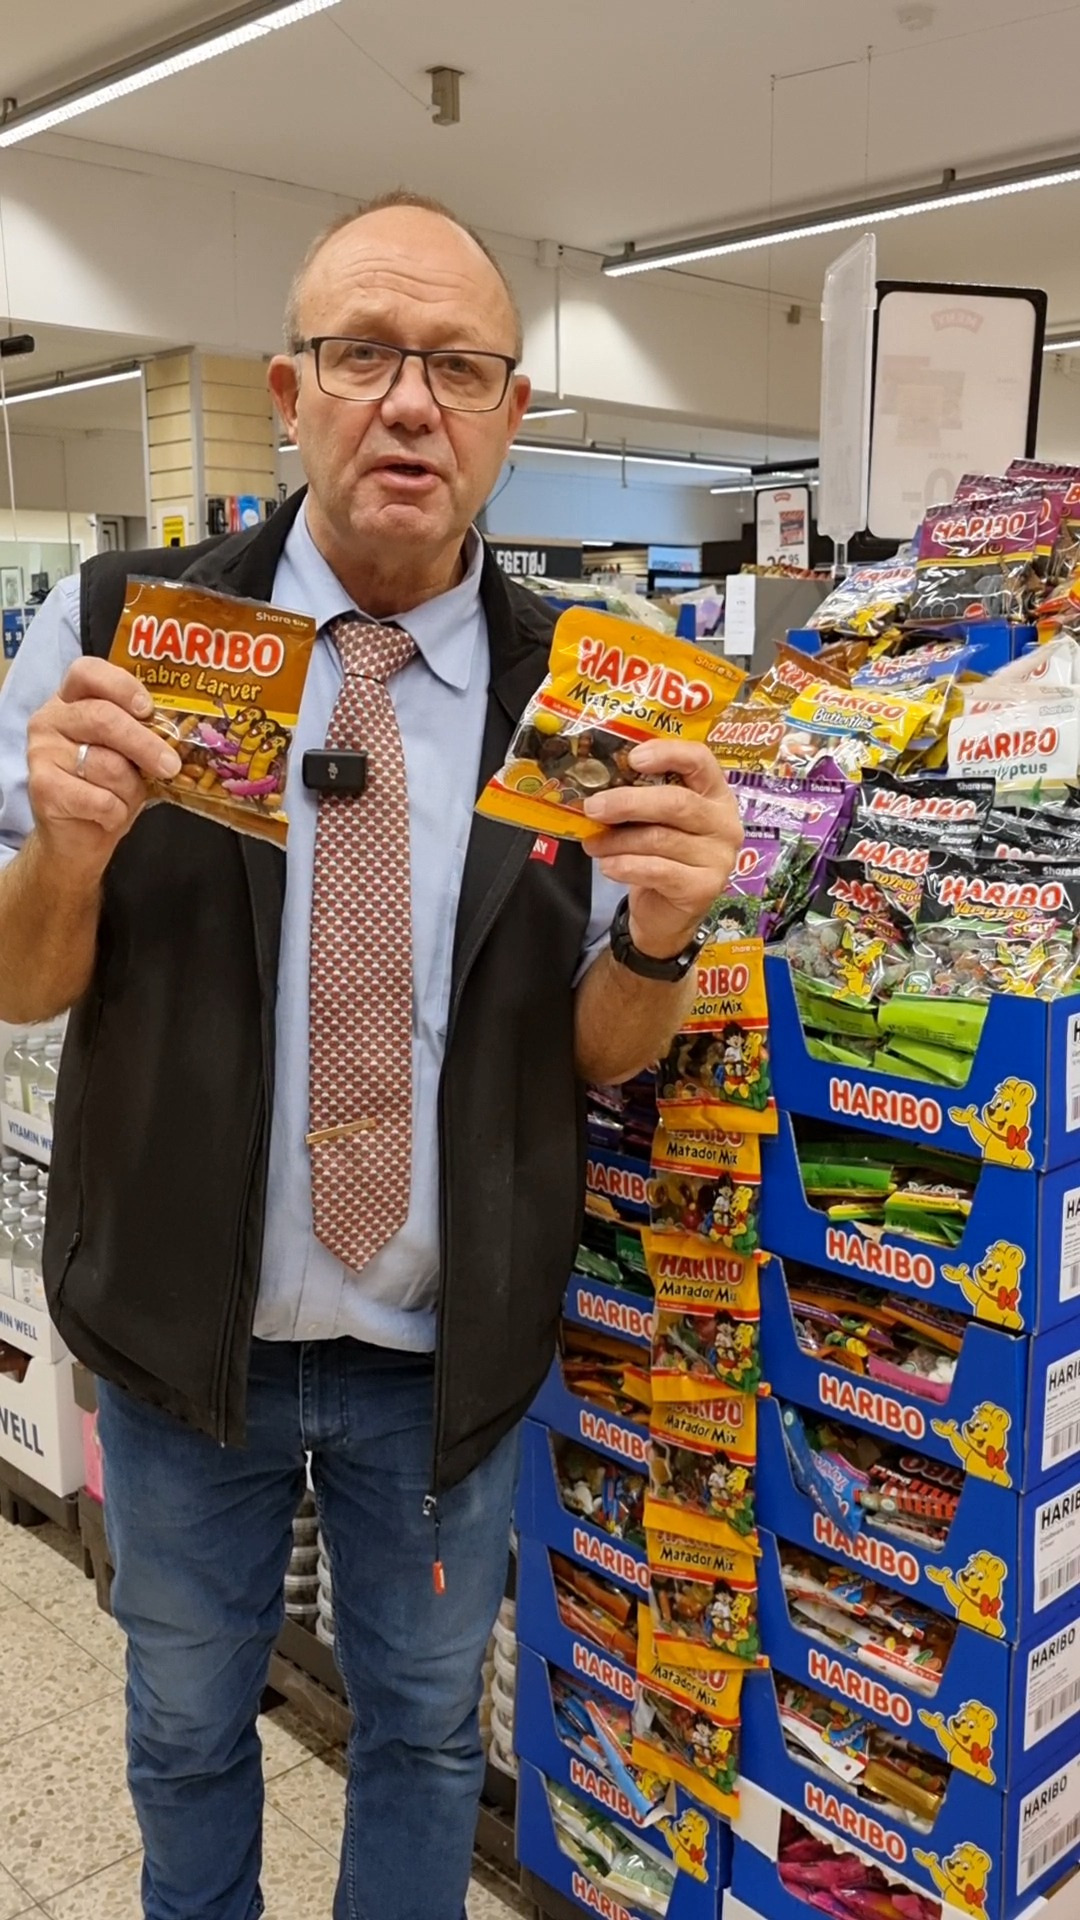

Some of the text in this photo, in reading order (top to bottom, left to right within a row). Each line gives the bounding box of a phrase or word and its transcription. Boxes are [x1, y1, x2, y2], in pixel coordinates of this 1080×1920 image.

[492, 550, 547, 575] EGETØJ
[256, 611, 291, 625] Share
[129, 614, 285, 677] HARIBO
[134, 664, 262, 701] Labre Larver
[577, 636, 713, 715] HARIBO
[695, 655, 725, 675] Share
[567, 681, 652, 724] Matador
[654, 715, 684, 736] Mix
[812, 707, 875, 730] Butterflies
[813, 687, 908, 721] HARIBO
[707, 721, 787, 747] HARIBO
[956, 726, 1060, 765] HARIBO
[847, 840, 930, 877] HARIB
[897, 892, 922, 902] Sou
[938, 876, 1064, 912] HARIBO
[697, 963, 749, 999] RIBO
[690, 1000, 743, 1016] ador Mix
[830, 1077, 943, 1134] HARIBO
[7, 1120, 40, 1147] VITAMIN
[666, 1141, 738, 1165] Matador Mix
[658, 1255, 744, 1286] HARIBO
[826, 1227, 935, 1290] HARIBO
[659, 1282, 714, 1300] Matador
[14, 1317, 38, 1341] WELL
[819, 1372, 926, 1440] HARIBO
[664, 1415, 737, 1445] Matador Mix
[573, 1527, 650, 1591] HARIBO
[660, 1546, 735, 1572] Matador Mix
[813, 1511, 920, 1585] HARIBO
[1031, 1628, 1076, 1671] HARIBO
[572, 1641, 635, 1702] HARIB
[651, 1661, 697, 1694] Matador
[696, 1689, 718, 1708] Mix
[808, 1648, 913, 1727] HARIBO
[1023, 1775, 1068, 1823] HARIBO
[804, 1781, 907, 1863] HARIBO
[571, 1870, 642, 1920] HARIB
